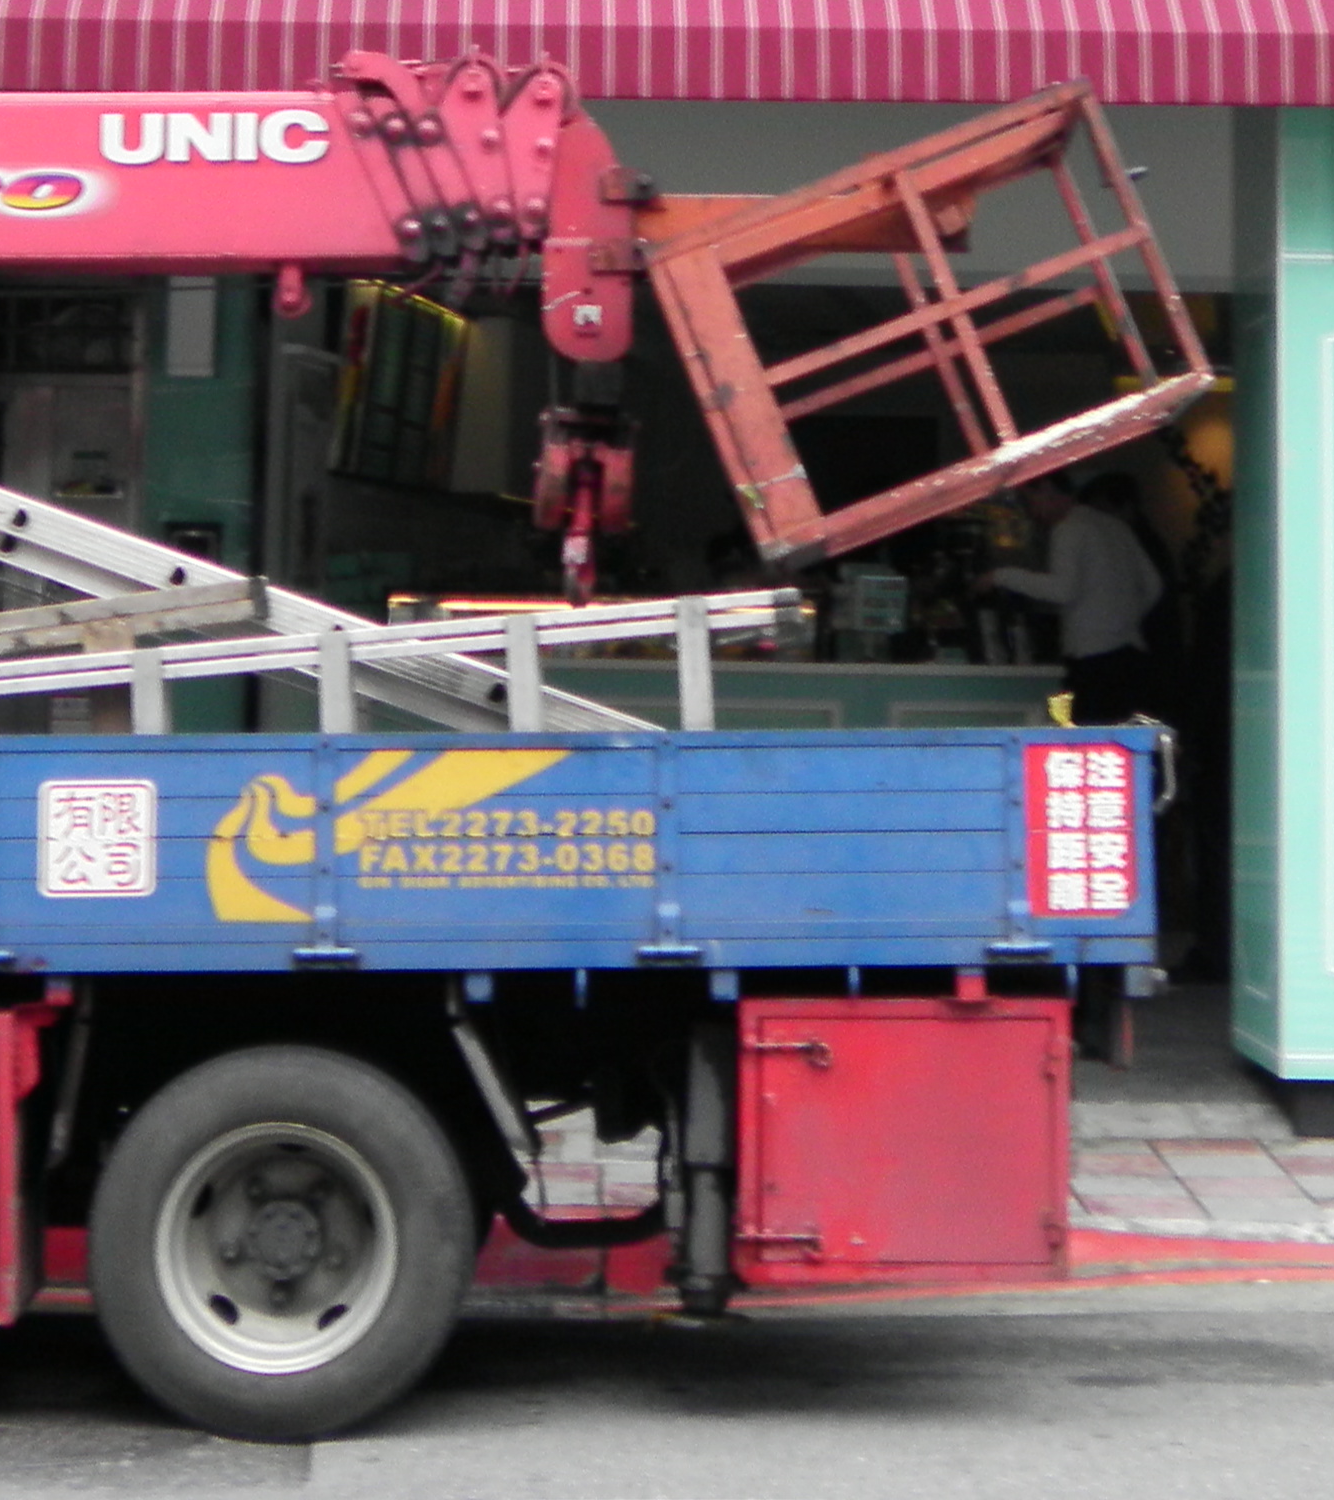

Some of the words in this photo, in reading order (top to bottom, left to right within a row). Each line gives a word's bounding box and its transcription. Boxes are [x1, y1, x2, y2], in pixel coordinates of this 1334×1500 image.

[99, 108, 330, 166] UNIC
[53, 790, 142, 835] 有限
[1087, 750, 1130, 910] 注意安全
[53, 842, 142, 887] 公司
